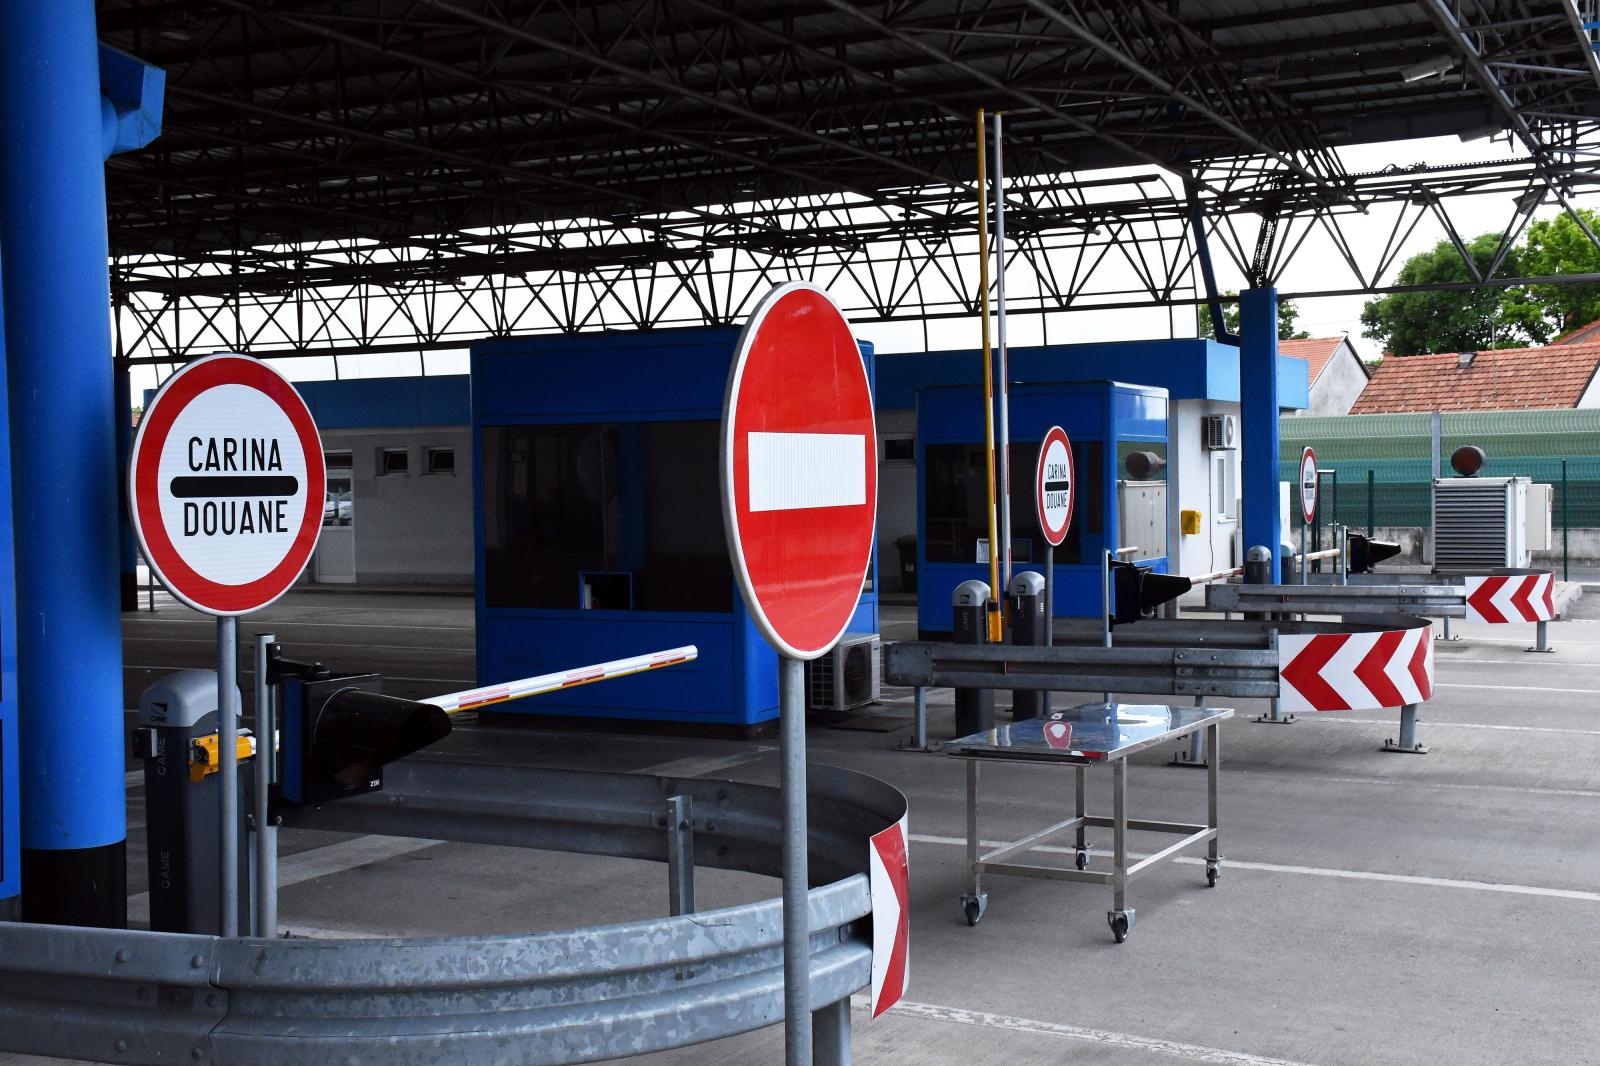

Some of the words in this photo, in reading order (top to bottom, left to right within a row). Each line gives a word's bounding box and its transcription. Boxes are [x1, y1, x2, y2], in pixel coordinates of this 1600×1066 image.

[188, 436, 282, 472] CARINA
[1047, 463, 1066, 480] CARINA
[183, 500, 288, 537] DOUANE
[1046, 492, 1067, 509] DOUANE
[157, 737, 167, 776] CAME
[160, 850, 170, 889] CAME
